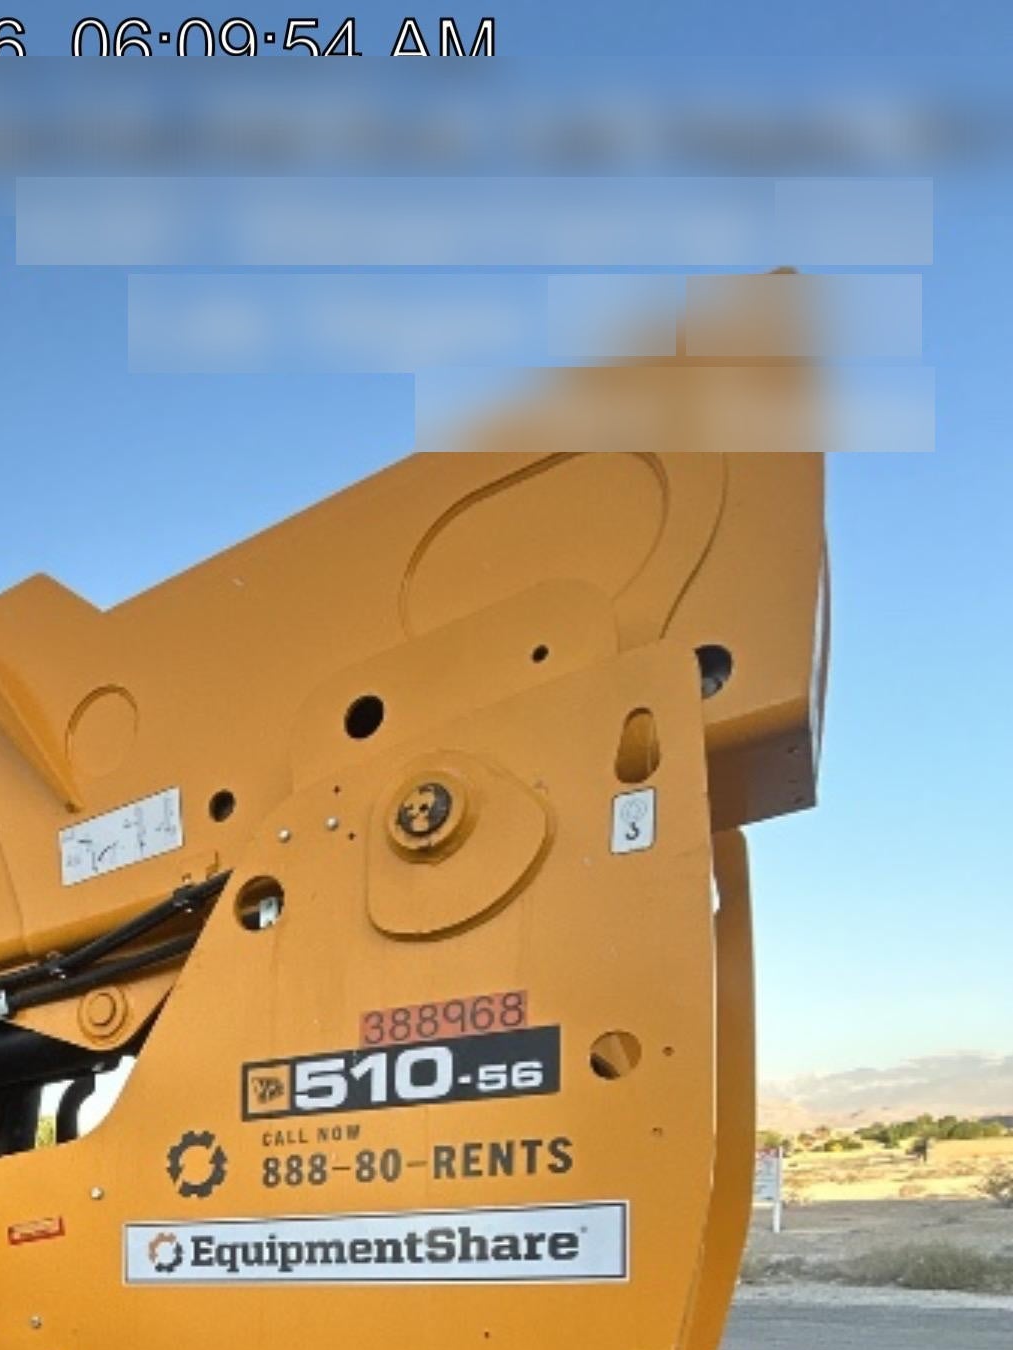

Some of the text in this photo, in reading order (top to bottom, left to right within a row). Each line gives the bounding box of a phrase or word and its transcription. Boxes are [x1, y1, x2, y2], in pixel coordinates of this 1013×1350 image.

[364, 992, 523, 1044] 388968
[261, 1124, 361, 1147] CALL NOW
[262, 1136, 574, 1188] 888-80-RENTS
[190, 1227, 580, 1273] EquipmentShare
